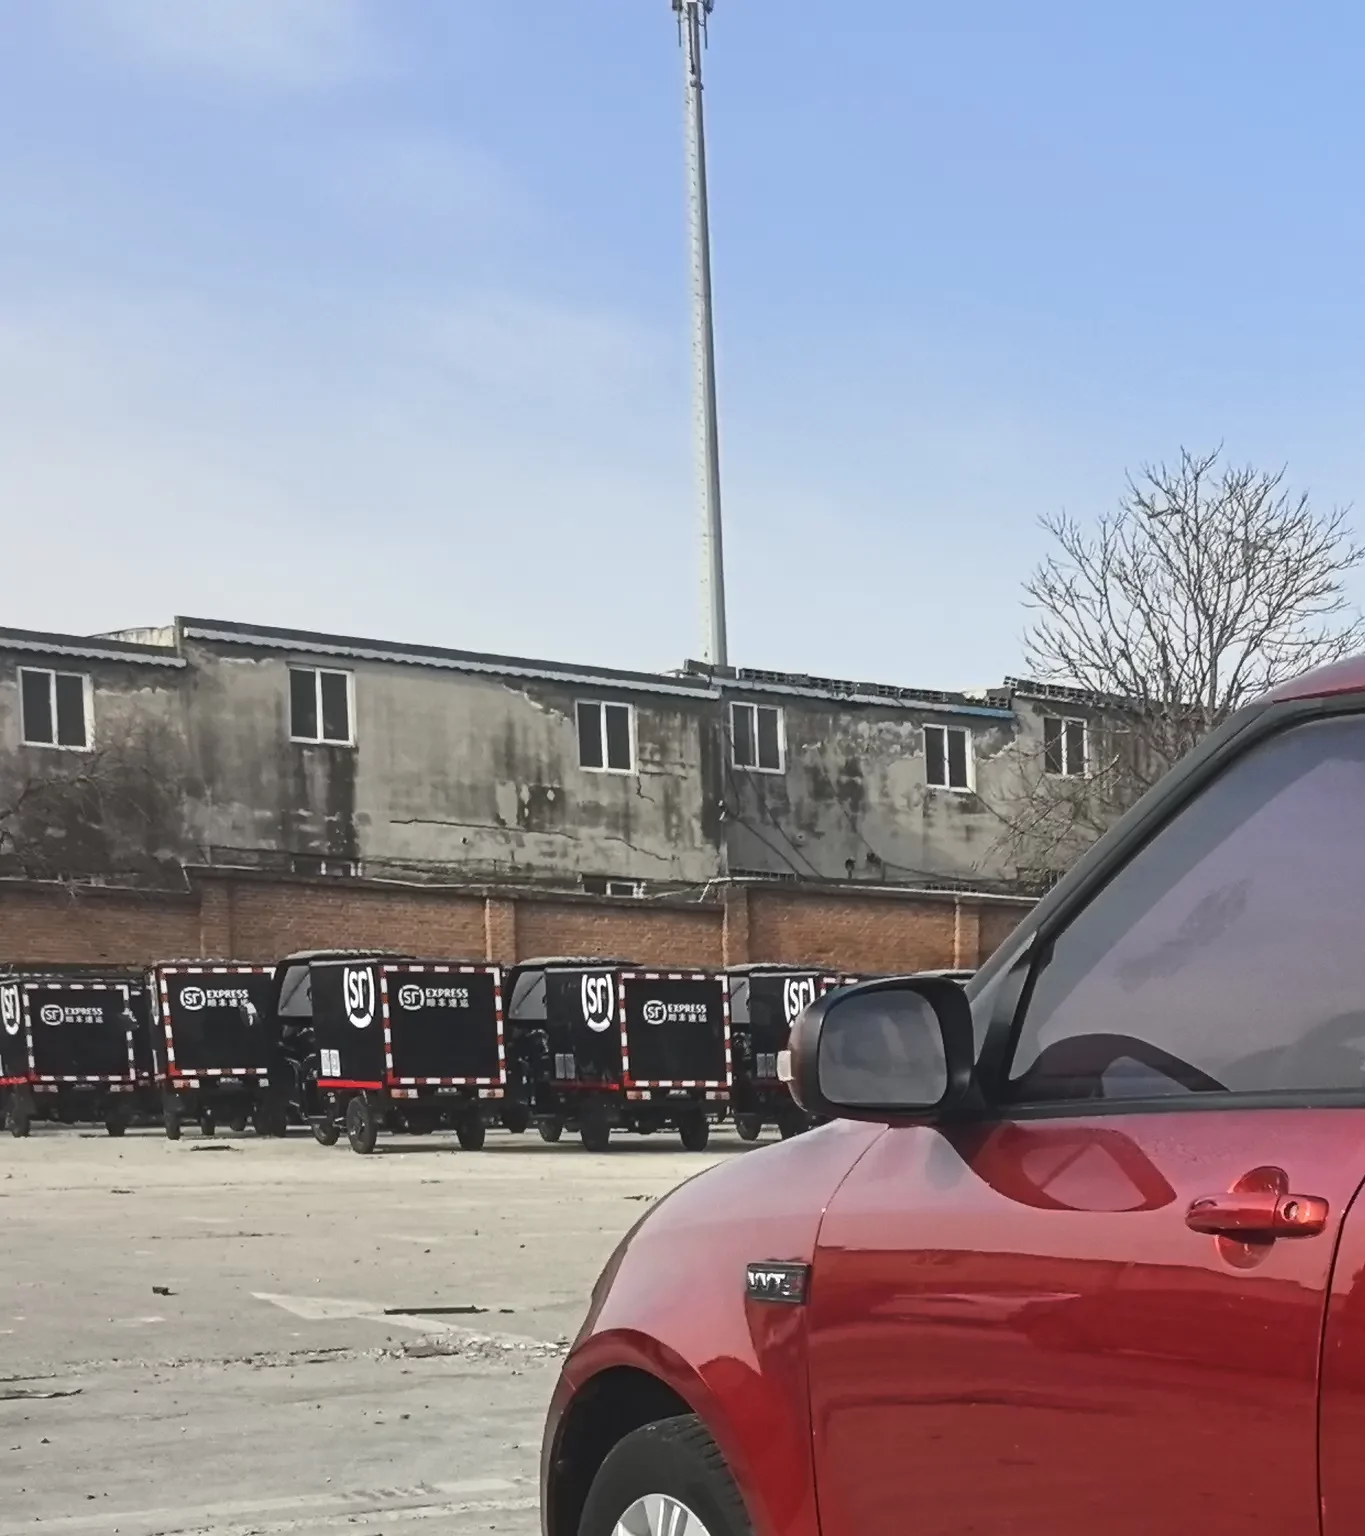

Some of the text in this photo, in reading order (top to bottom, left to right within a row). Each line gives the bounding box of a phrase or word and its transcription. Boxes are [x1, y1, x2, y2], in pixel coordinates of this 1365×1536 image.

[206, 989, 249, 999] EXPRESS
[425, 988, 469, 998] EXPRESS
[65, 1006, 103, 1015] EXPRESS
[667, 1004, 707, 1013] EXPRESS
